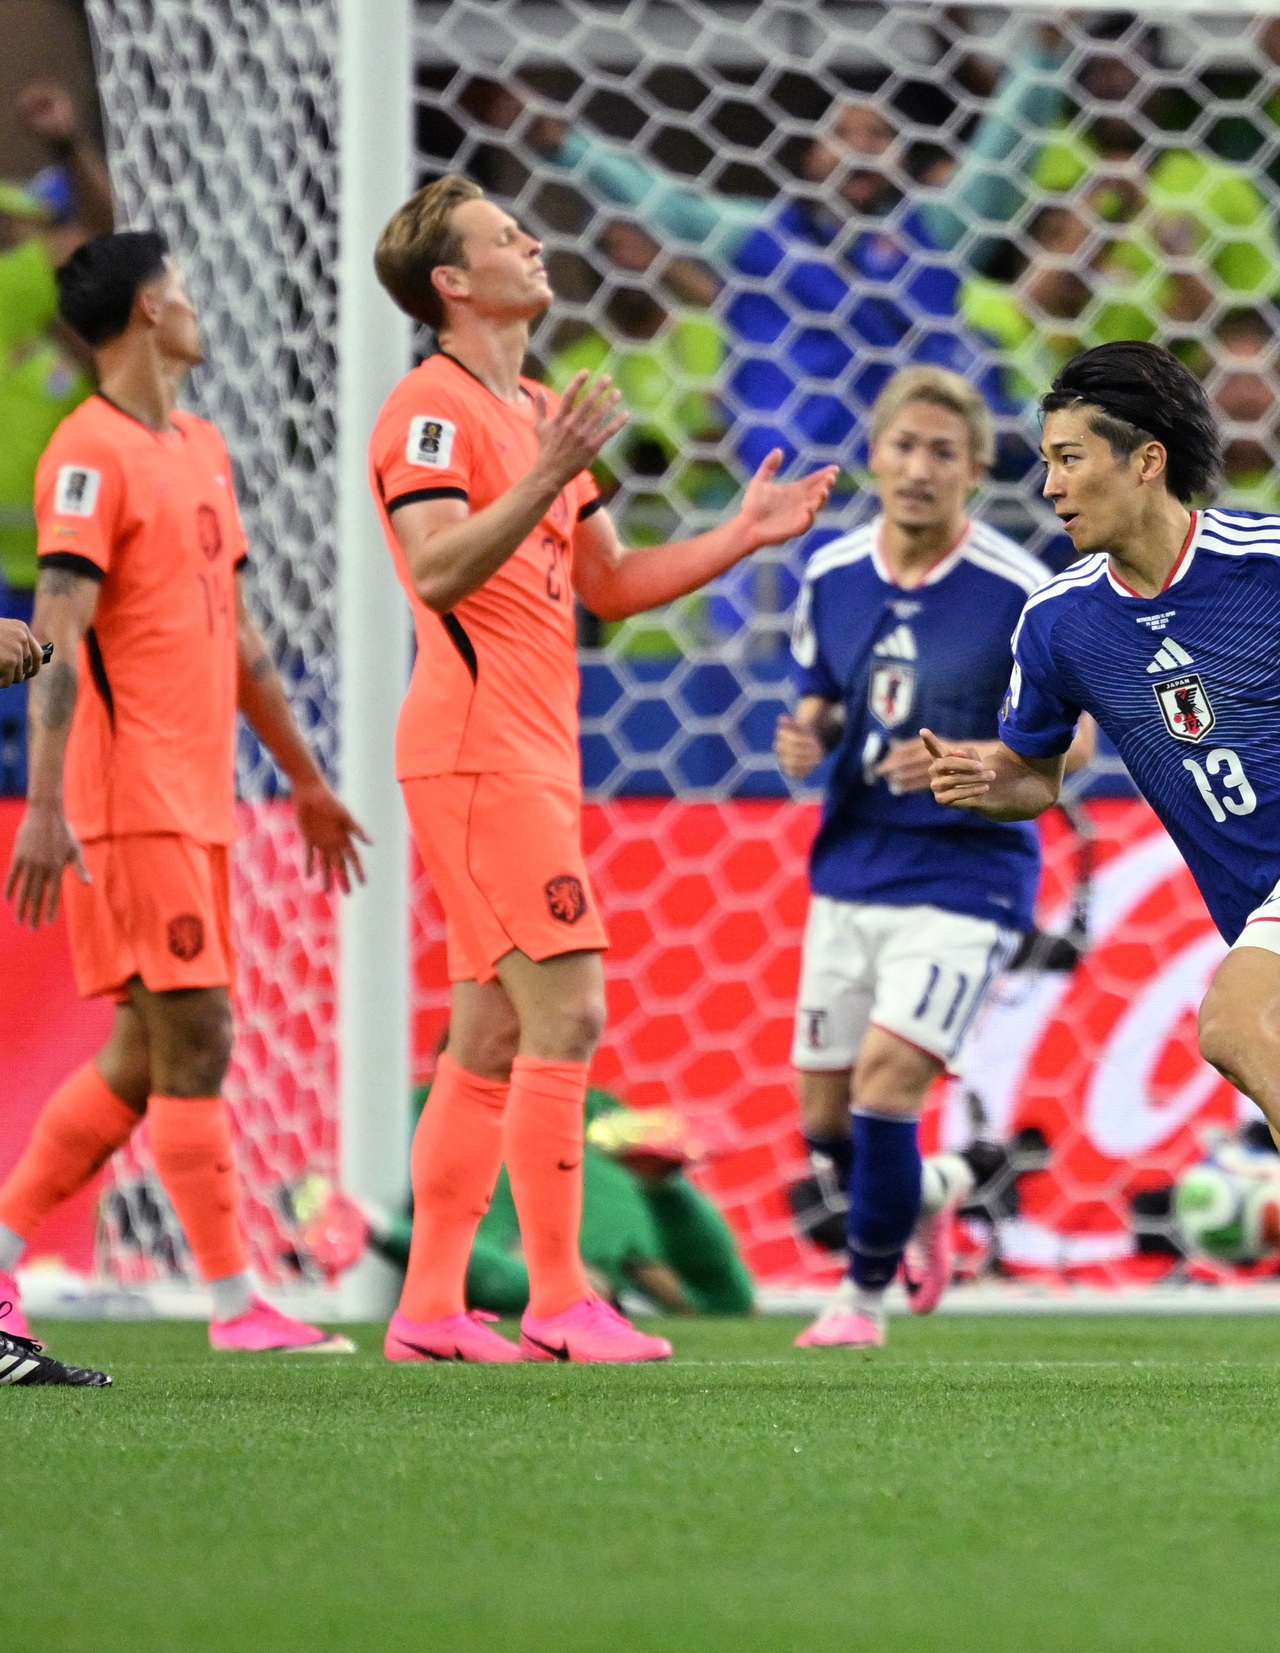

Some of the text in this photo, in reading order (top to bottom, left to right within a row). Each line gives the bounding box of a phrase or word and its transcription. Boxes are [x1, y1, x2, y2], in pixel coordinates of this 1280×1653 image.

[1166, 678, 1190, 689] JAPAN
[1182, 719, 1204, 733] JFA
[1182, 748, 1257, 823] 13
[913, 963, 968, 1032] 11
